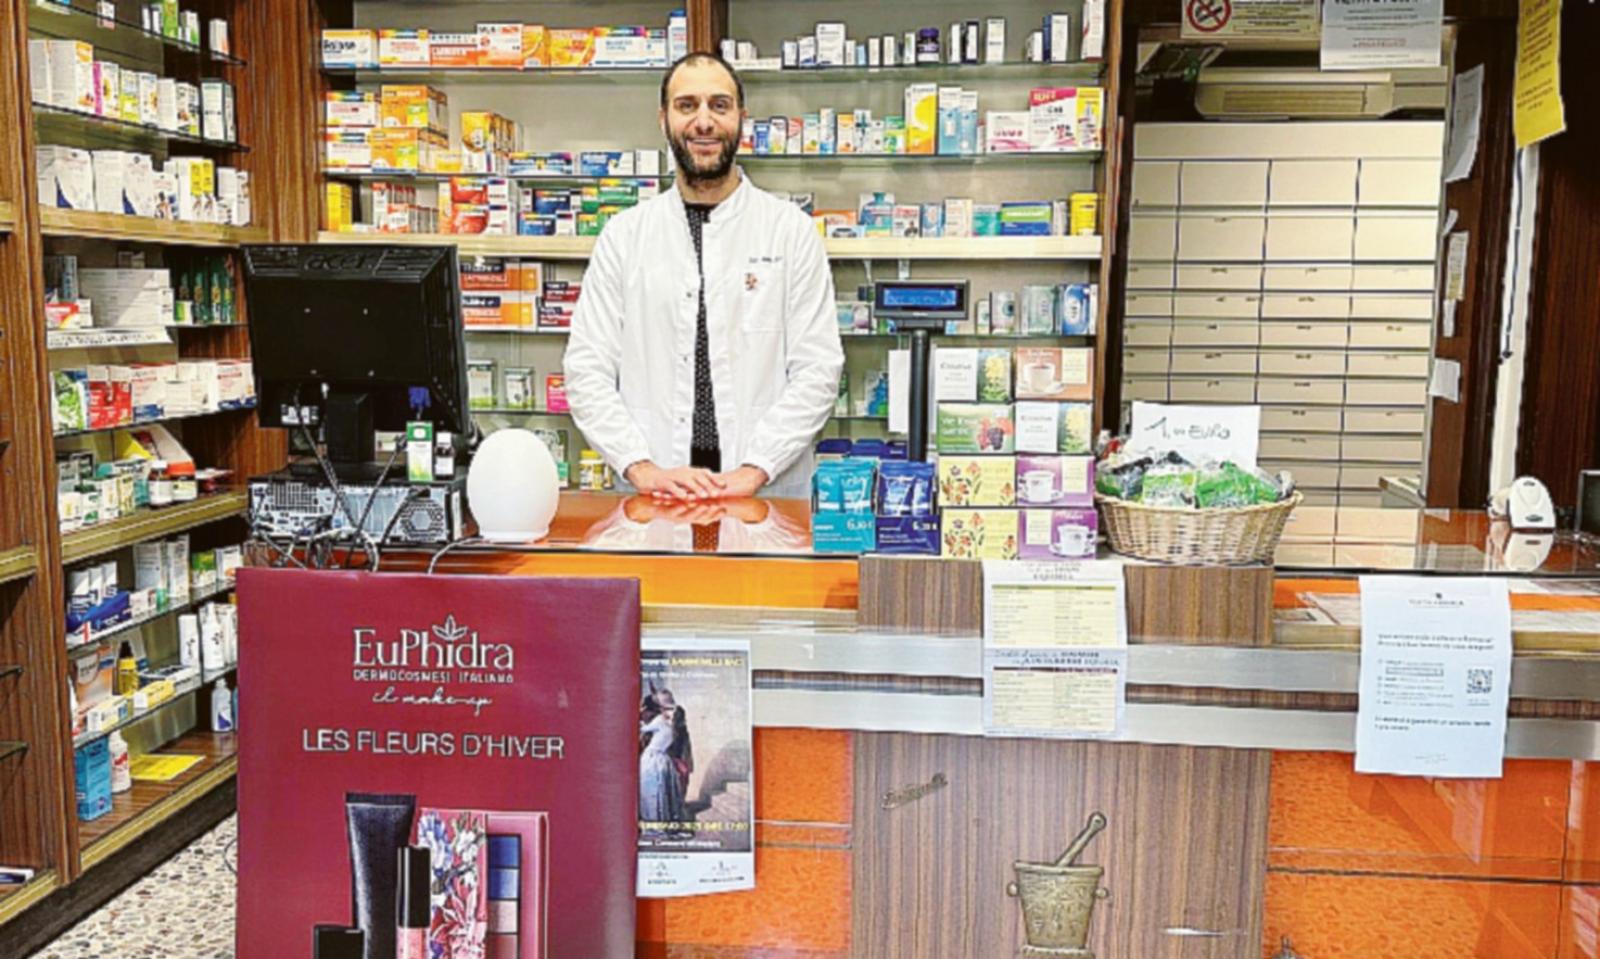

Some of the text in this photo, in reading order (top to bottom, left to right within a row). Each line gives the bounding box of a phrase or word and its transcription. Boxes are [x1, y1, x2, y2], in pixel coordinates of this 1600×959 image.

[353, 628, 515, 670] EuPhidra
[353, 669, 451, 683] DERMOCOSMESI
[302, 728, 565, 760] LES FLEURS D'HIVER
